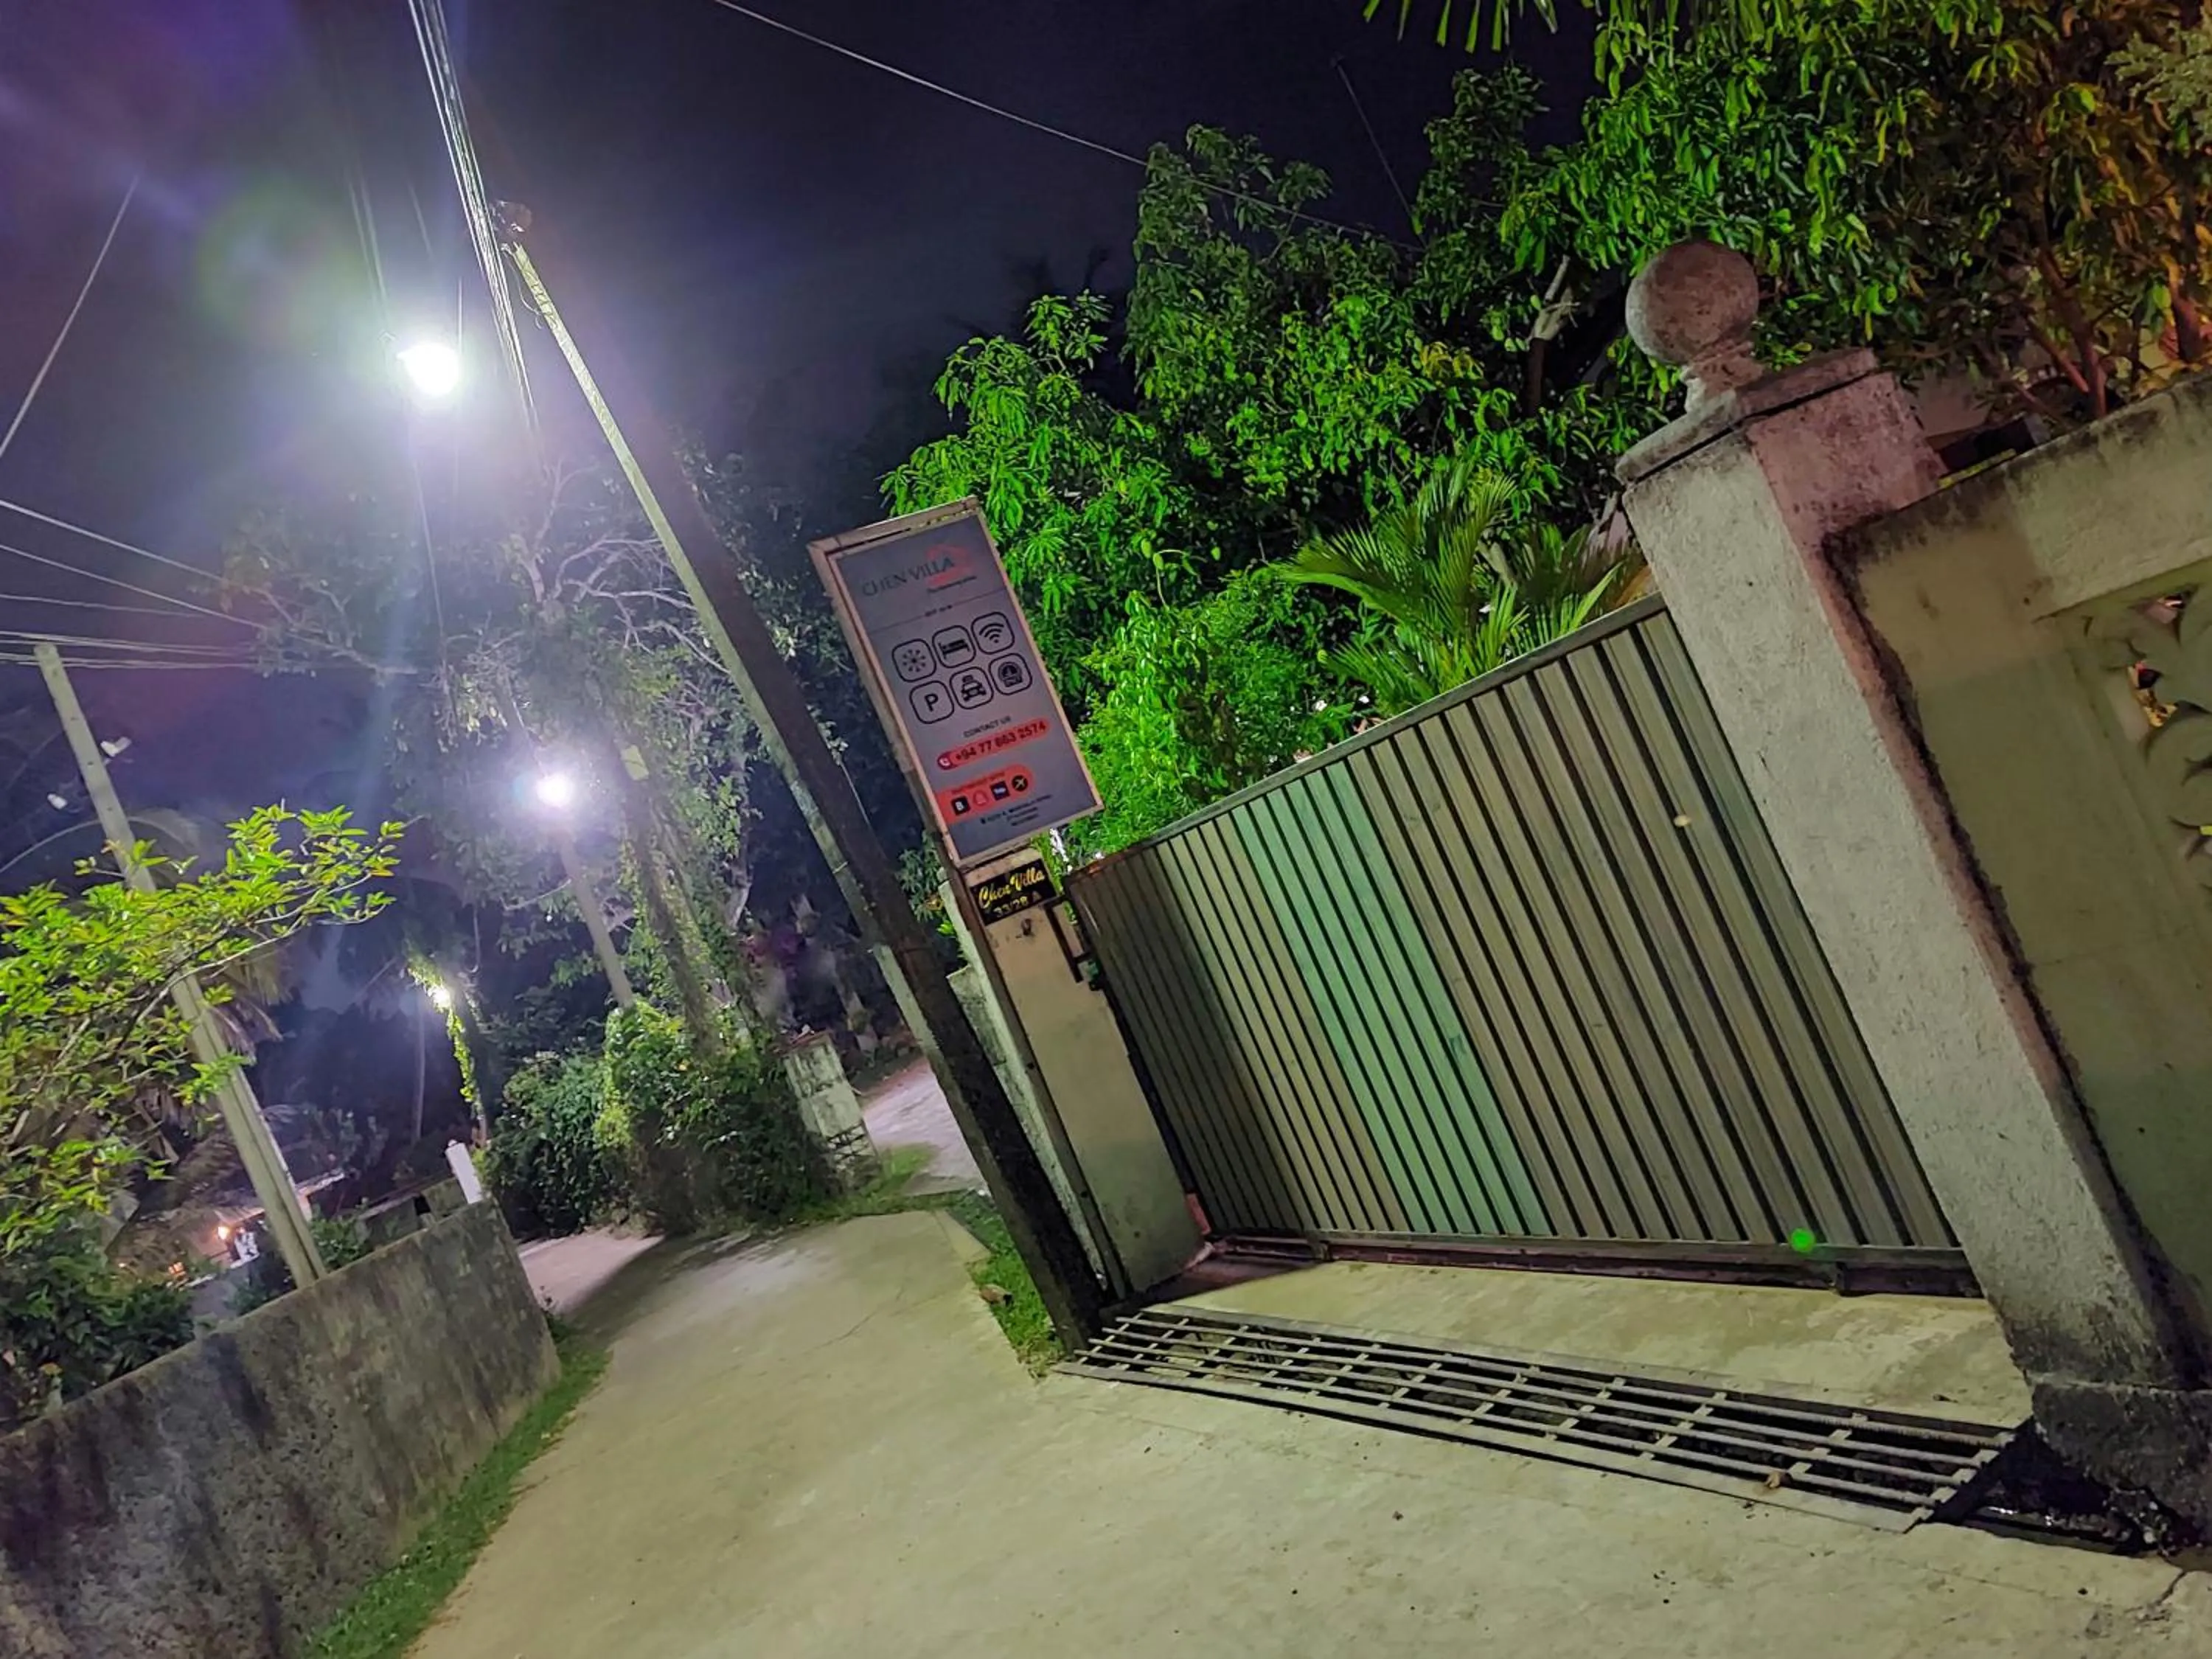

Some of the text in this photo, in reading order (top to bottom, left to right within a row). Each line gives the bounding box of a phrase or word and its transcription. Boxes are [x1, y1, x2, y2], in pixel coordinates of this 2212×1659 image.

[908, 557, 954, 580] VILLA
[925, 694, 938, 712] P
[963, 720, 998, 737] CONTACT
[979, 740, 992, 753] 77
[978, 867, 1045, 909] Chen Villa
